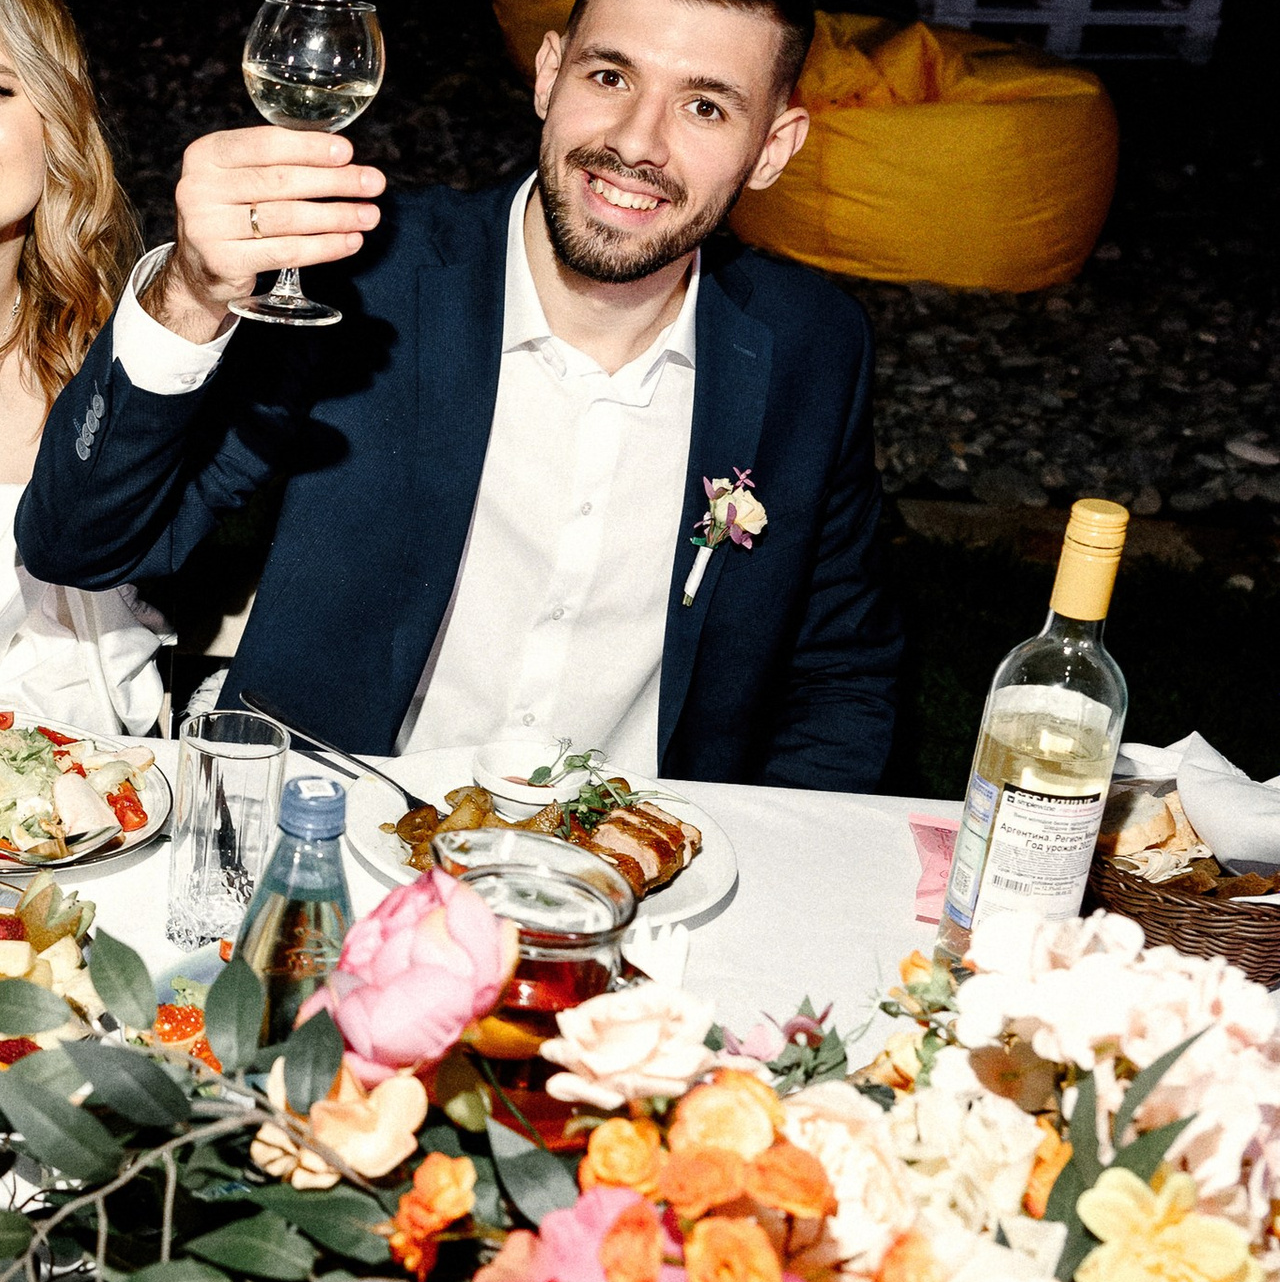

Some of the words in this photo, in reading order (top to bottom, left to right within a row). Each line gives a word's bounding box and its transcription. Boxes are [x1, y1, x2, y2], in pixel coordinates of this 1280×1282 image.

[1000, 822, 1052, 842] Аргентина.
[1054, 834, 1083, 843] Регион
[1025, 839, 1044, 850] Год
[1046, 843, 1078, 853] урожая
